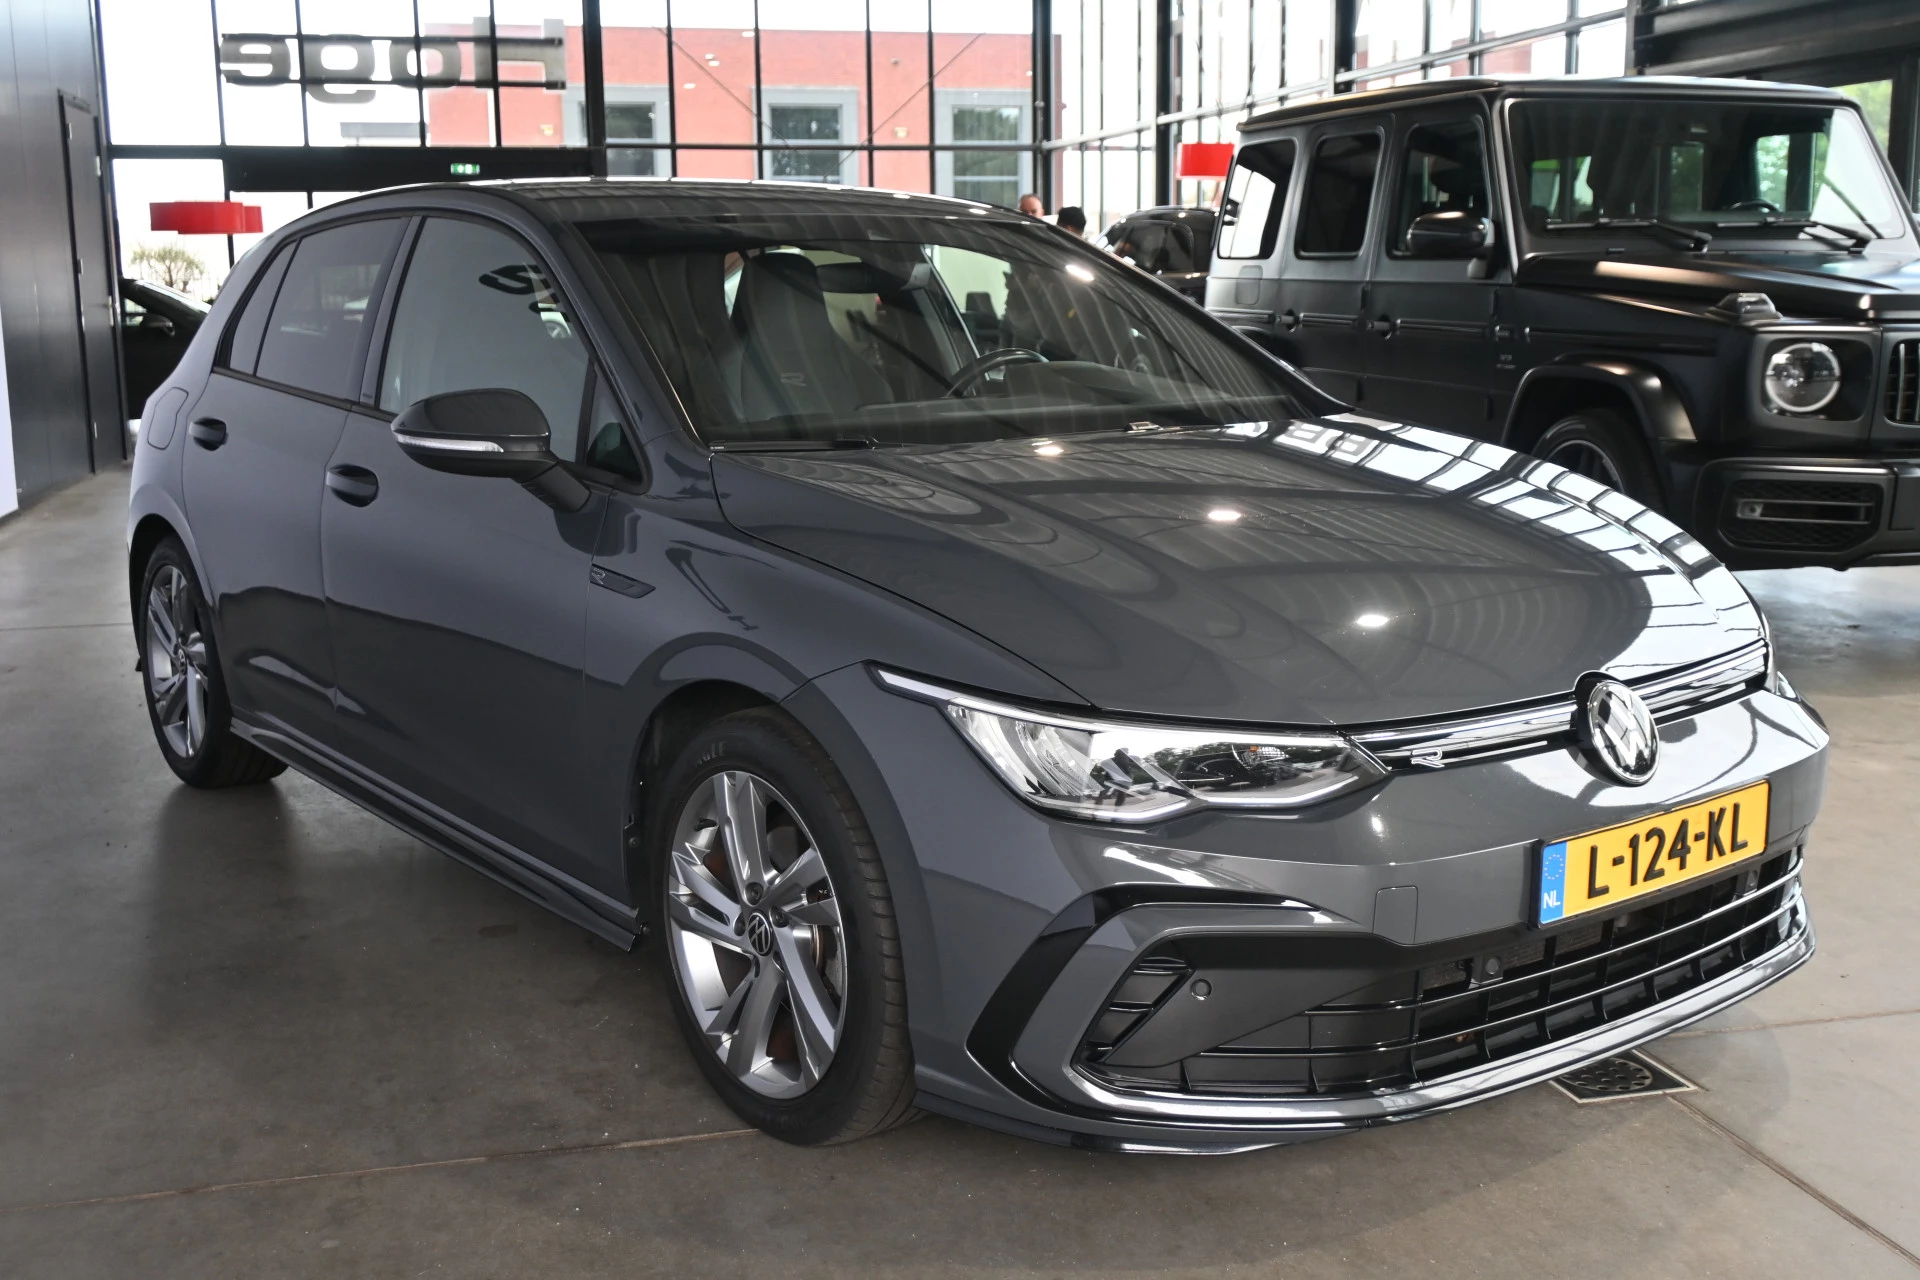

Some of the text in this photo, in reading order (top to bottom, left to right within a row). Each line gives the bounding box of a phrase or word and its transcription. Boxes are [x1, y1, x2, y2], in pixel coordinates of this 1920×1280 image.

[591, 568, 606, 584] R
[1410, 747, 1446, 768] R
[1587, 802, 1749, 900] L-124-KL
[1543, 890, 1561, 909] NL
